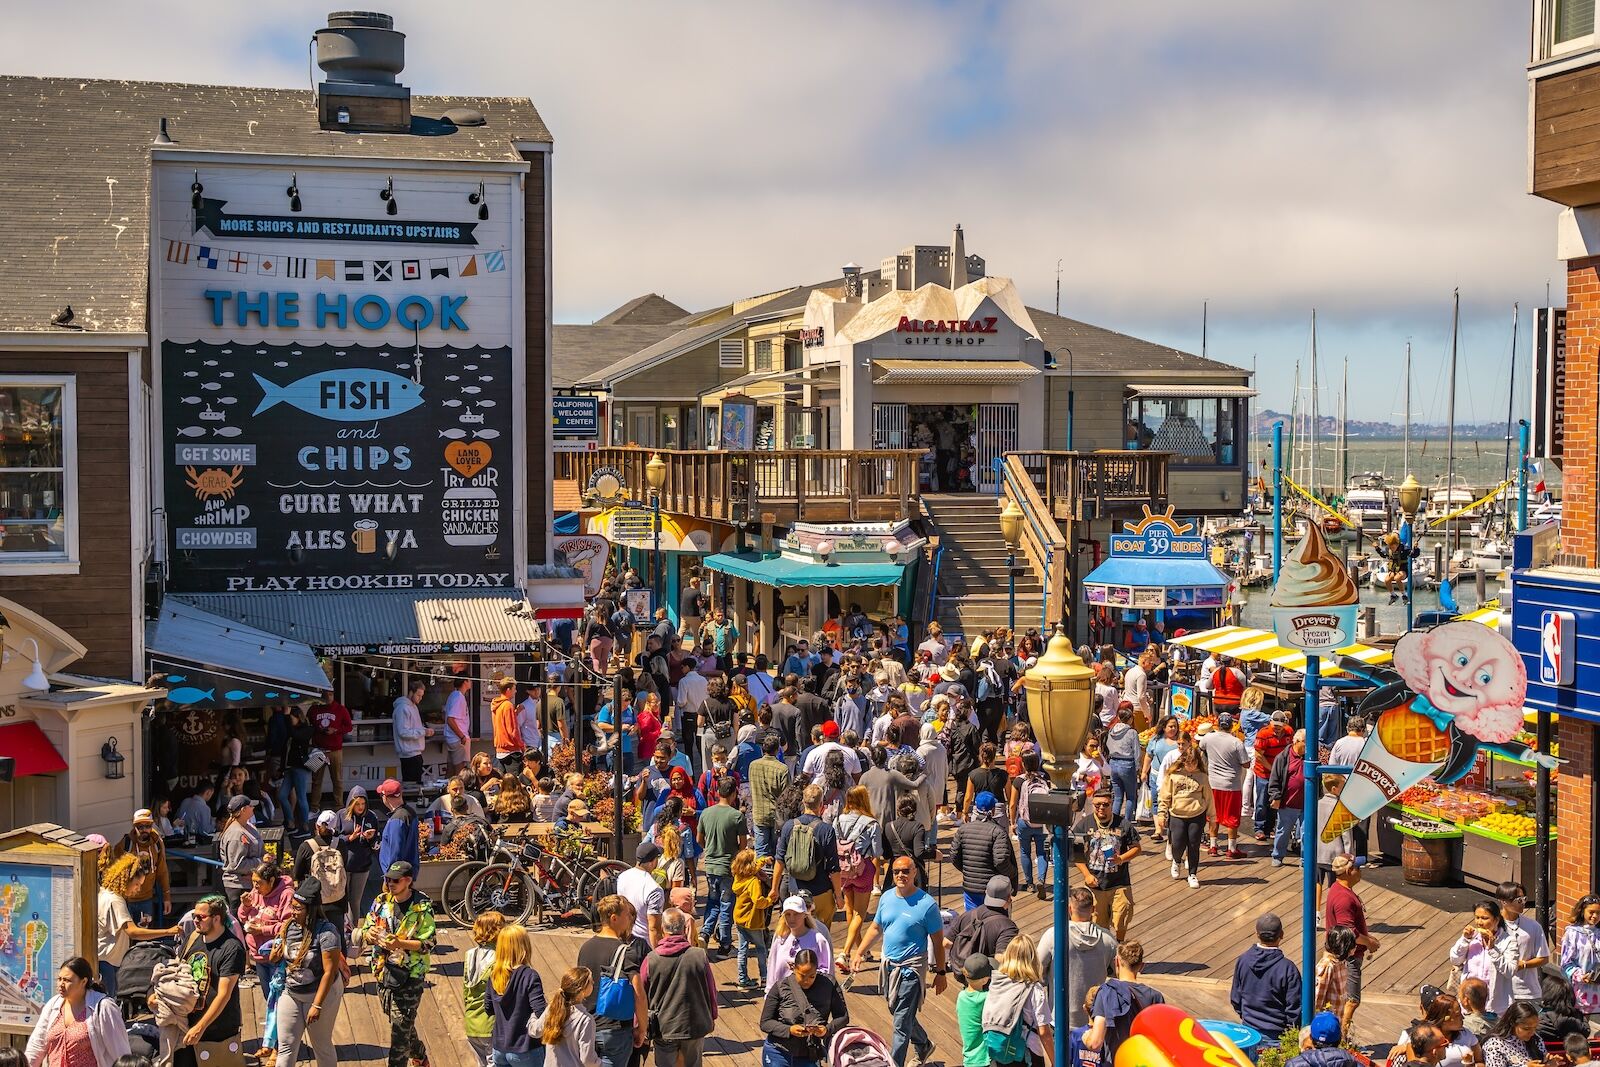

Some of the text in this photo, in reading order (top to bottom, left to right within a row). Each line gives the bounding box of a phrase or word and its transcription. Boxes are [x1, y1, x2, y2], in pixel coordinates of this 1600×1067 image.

[220, 219, 460, 239] MORE SHOPS AND RESTAURANTS UPSTAIRS
[204, 289, 470, 331] THE HOOK
[896, 316, 998, 333] ALCATRAZ
[905, 337, 985, 345] GIFT SHOP
[320, 381, 390, 410] FISH
[558, 409, 594, 417] WELCOME
[336, 421, 381, 440] and
[182, 447, 251, 462] GET SOME
[297, 445, 412, 471] CHIPS
[458, 449, 480, 457] LAND
[456, 457, 482, 465] LOVER
[466, 465, 472, 473] ?
[202, 474, 228, 489] CRAB
[440, 467, 465, 488] TRY
[204, 499, 225, 512] AND
[279, 493, 424, 514] CURE WHAT
[441, 499, 500, 508] GRILLED
[194, 504, 251, 525] SHRIMP
[442, 509, 499, 522] CHICKEN
[442, 521, 499, 535] SANDWICHES
[181, 531, 252, 545] CHOWDER
[285, 529, 419, 550] ALES YA
[1147, 529, 1169, 554] PIER 39
[1113, 540, 1203, 553] BOAT RIDES
[226, 572, 509, 592] PLAY HOOKIE TODAY
[1294, 615, 1337, 628] Dreyer's
[1302, 628, 1330, 638] Frozen
[1302, 637, 1331, 646] Yogurt
[324, 642, 525, 656] FISH WRAP CHICKEN STRIPS SALMON SANDWICH
[1543, 666, 1554, 680] NBA
[1356, 760, 1396, 797] Dreyer's
